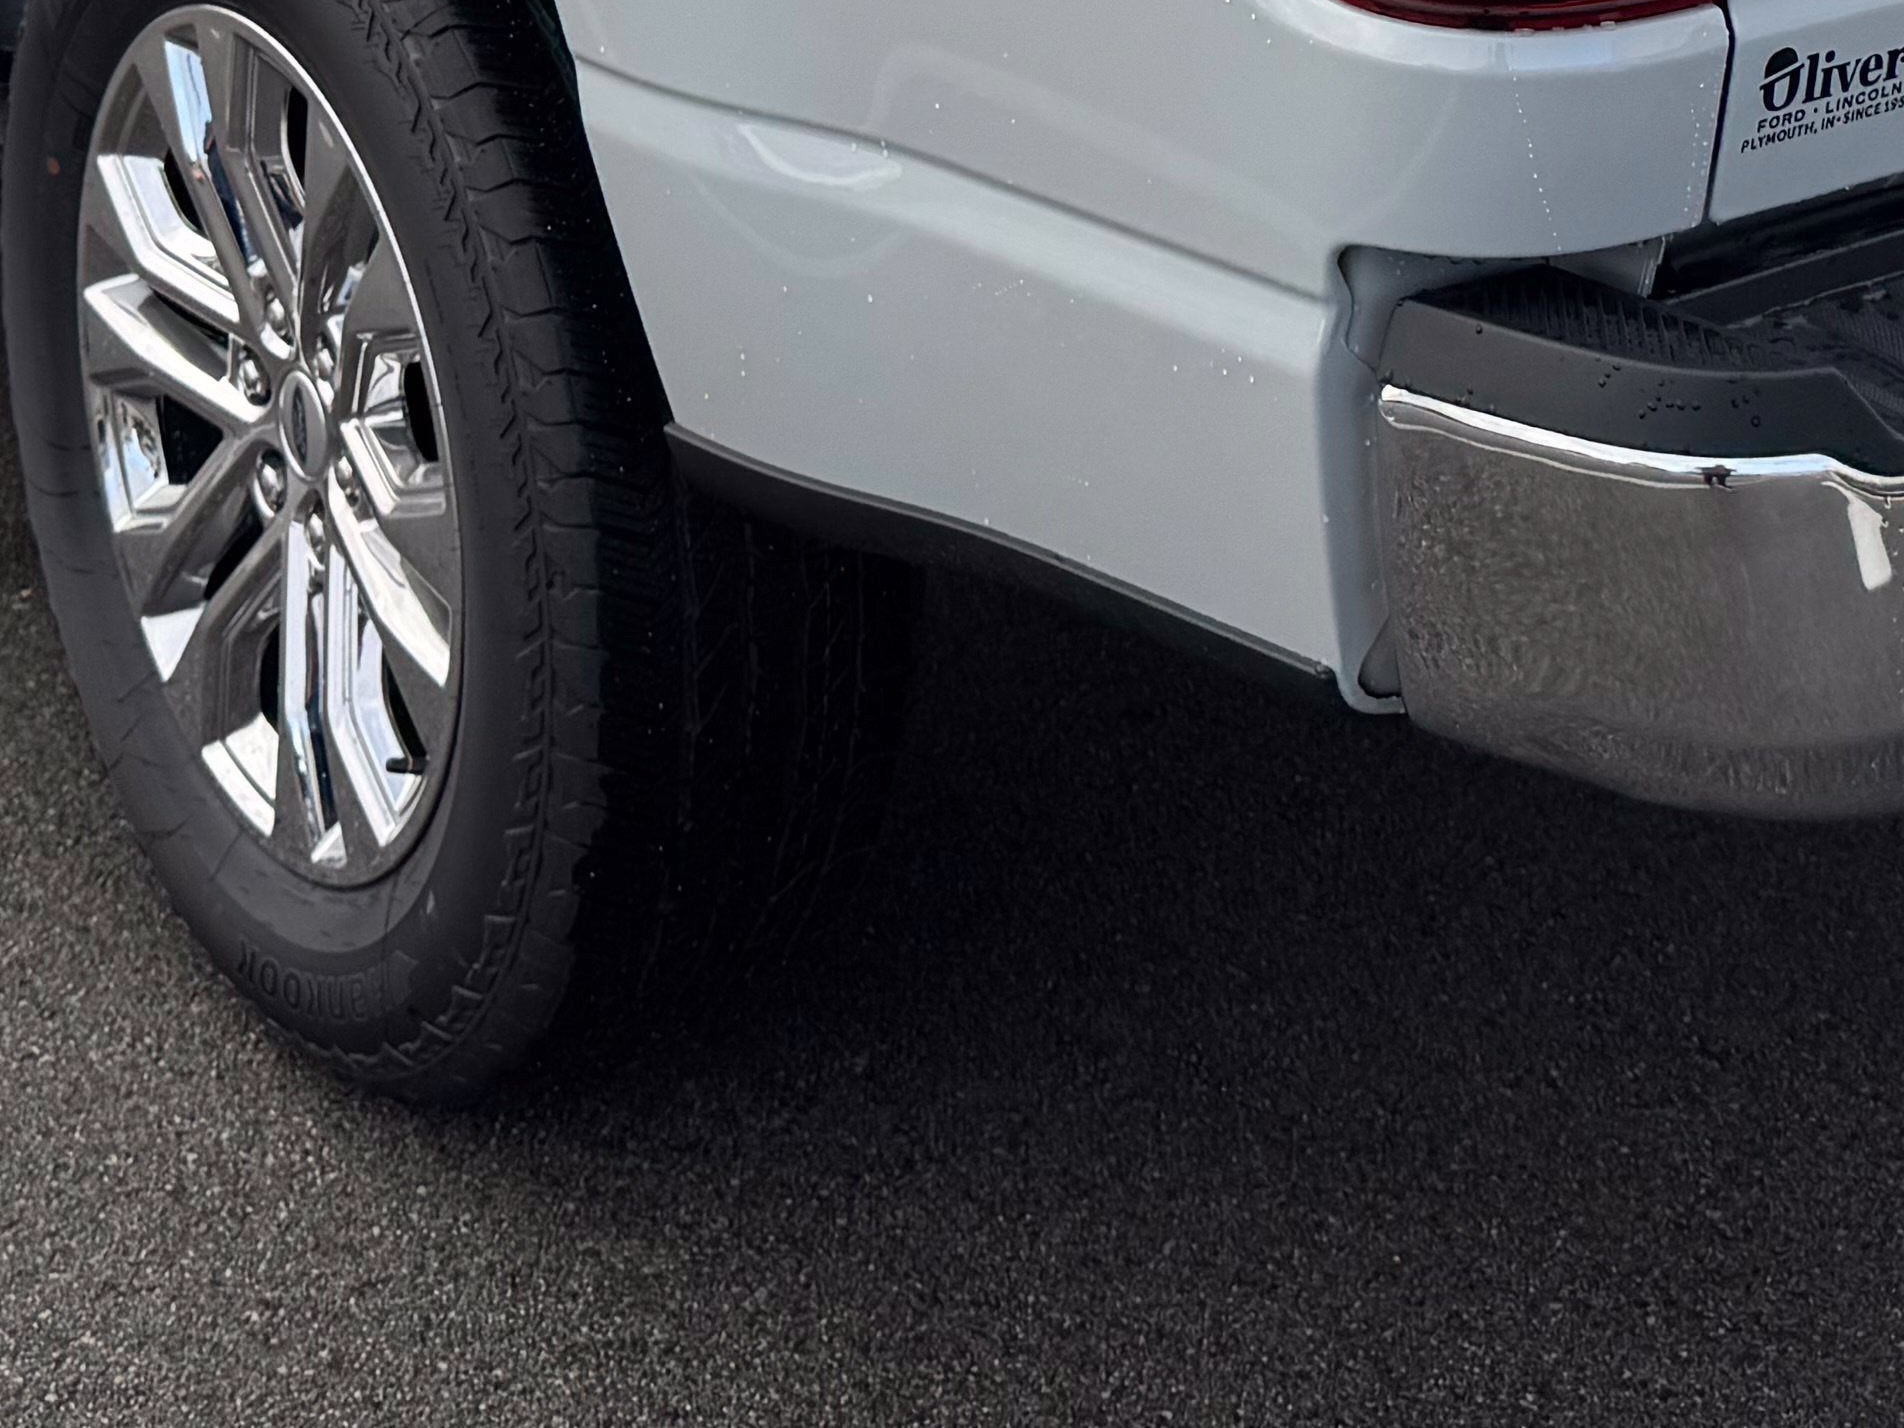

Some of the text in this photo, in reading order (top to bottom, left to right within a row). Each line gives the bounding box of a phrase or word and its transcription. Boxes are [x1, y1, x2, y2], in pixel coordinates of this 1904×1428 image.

[1757, 81, 1903, 133] FORD LINCOLN
[1741, 122, 1817, 153] PLYMOUTH,
